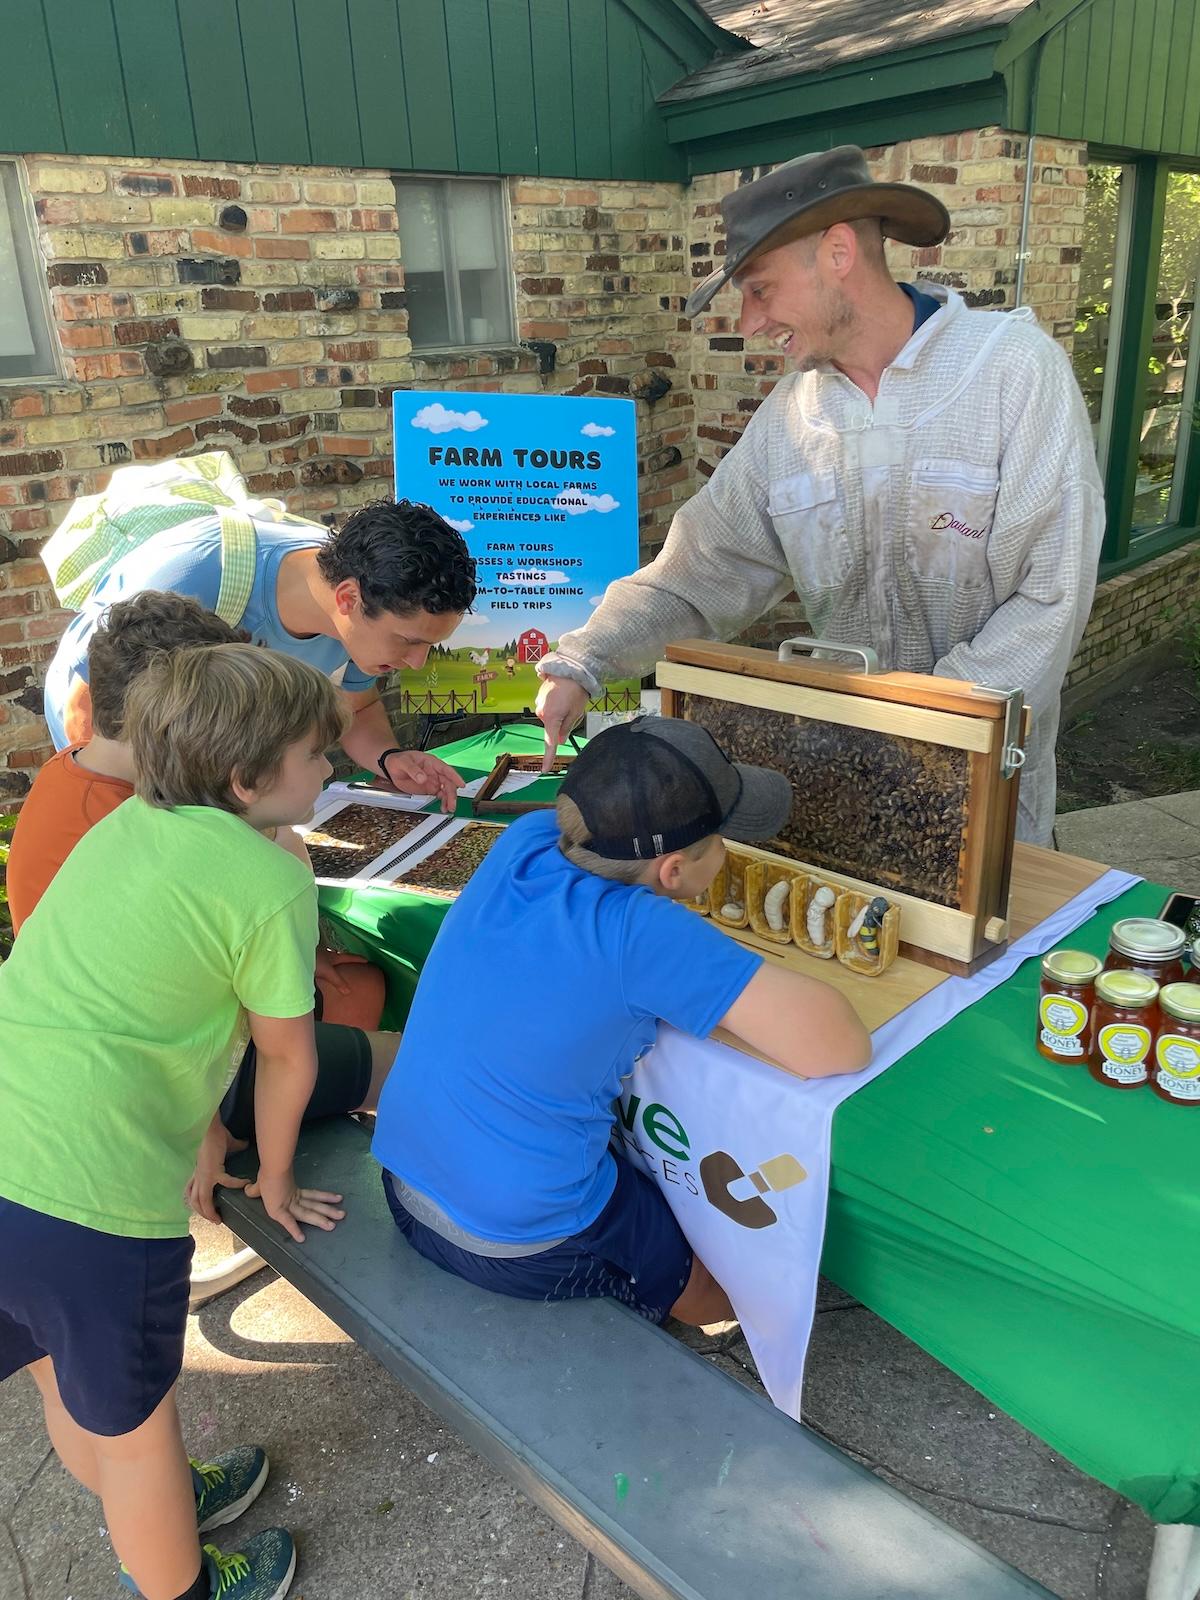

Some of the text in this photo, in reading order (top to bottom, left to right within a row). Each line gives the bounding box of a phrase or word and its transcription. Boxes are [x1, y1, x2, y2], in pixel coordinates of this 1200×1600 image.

[429, 447, 602, 470] FARM TOURS
[439, 478, 597, 490] WE WORK WITH LOCAL FARMS
[450, 495, 588, 506] TO PROVIDE EDUCATIONAL
[473, 512, 566, 522] EXPERIENCES LIKE
[487, 543, 554, 552] FARM TOURS
[507, 558, 514, 566] &
[517, 558, 583, 567] WORKSHOPS
[496, 572, 547, 581] TASTINGS
[549, 587, 584, 595] DINING
[491, 601, 553, 610] FIELD TRIPS
[1042, 1033, 1077, 1048] HONEY
[1105, 1064, 1143, 1075] HONEY
[1159, 1074, 1200, 1091] HONEY
